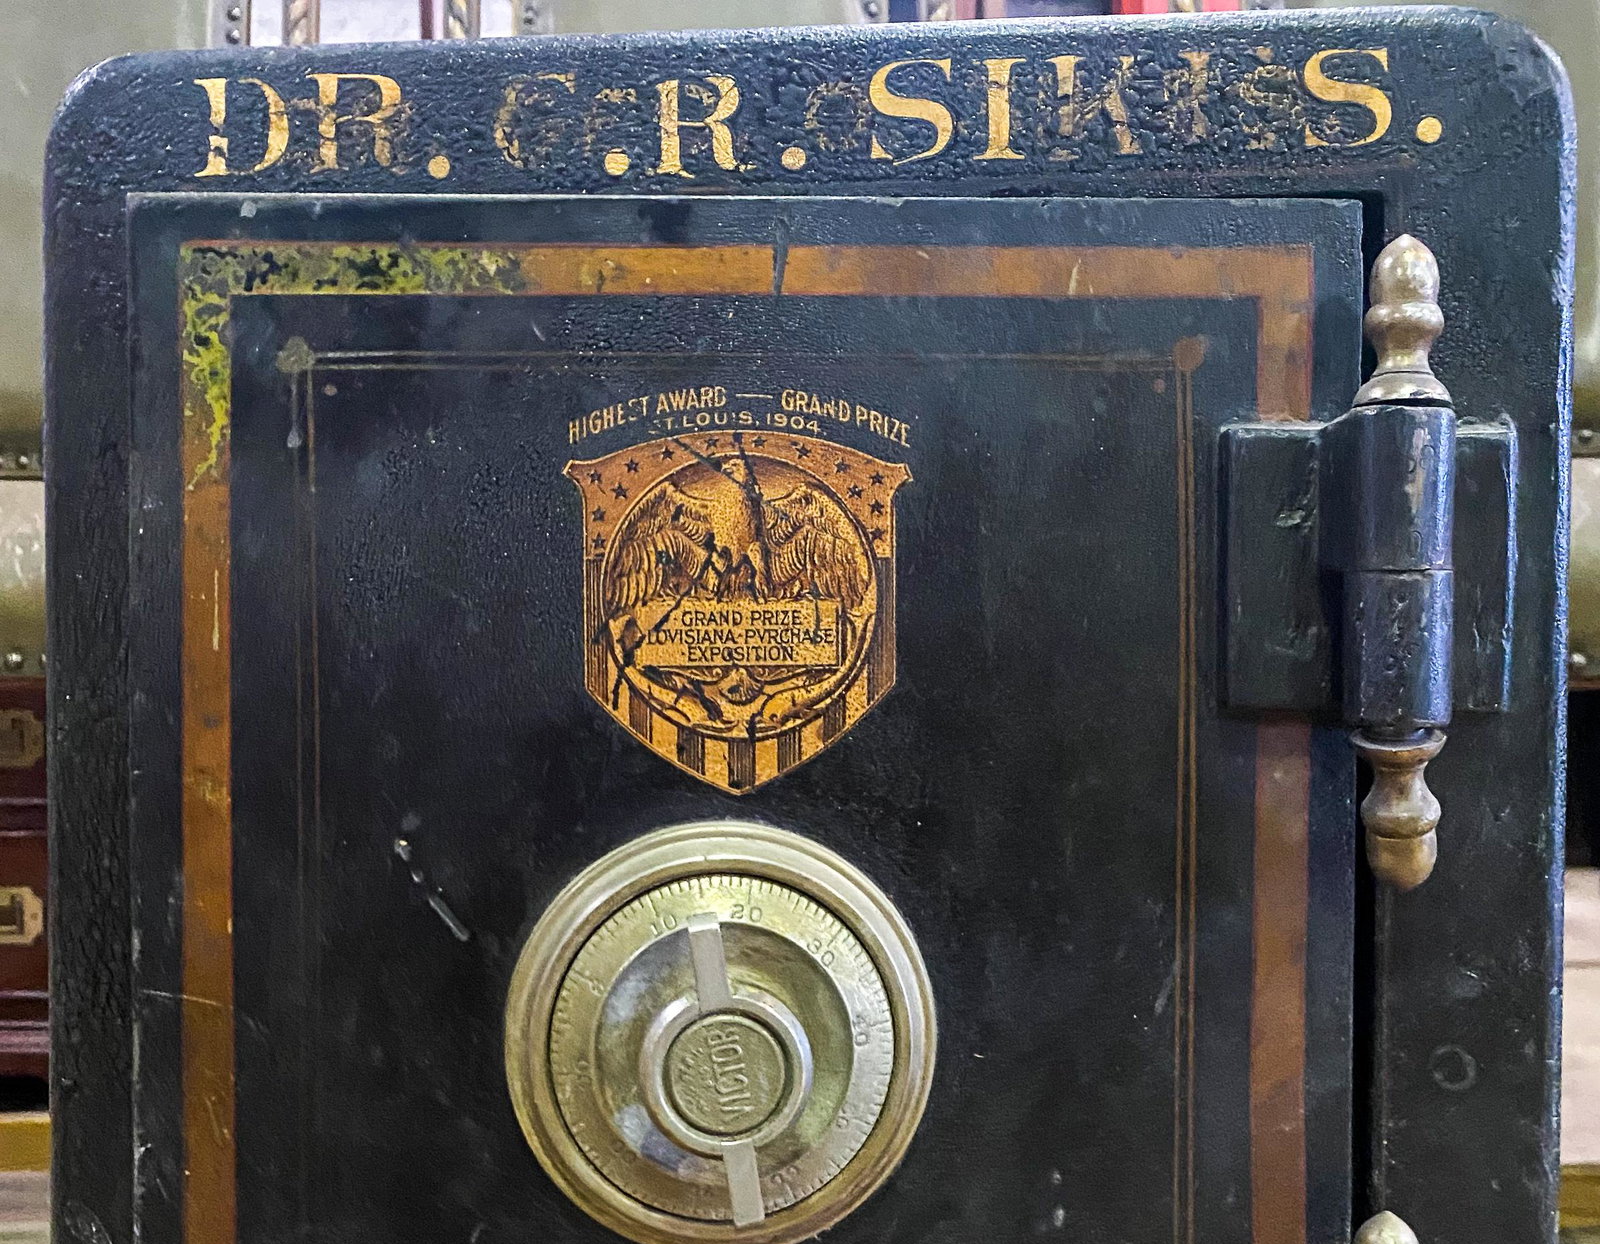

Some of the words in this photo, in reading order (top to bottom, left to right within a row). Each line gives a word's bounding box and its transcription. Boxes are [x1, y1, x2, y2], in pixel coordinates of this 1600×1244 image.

[194, 72, 451, 180] DR.
[568, 395, 649, 444] HIGHEST
[656, 386, 727, 416] AWARD
[781, 389, 850, 423] GRAND
[855, 404, 911, 447] PRIZE
[681, 610, 744, 627] GRAND
[750, 609, 803, 626] PRIZE
[687, 646, 795, 663] EXPOSITION
[730, 903, 764, 924] 20
[806, 937, 835, 969] 30
[708, 1026, 752, 1114] VICTOR
